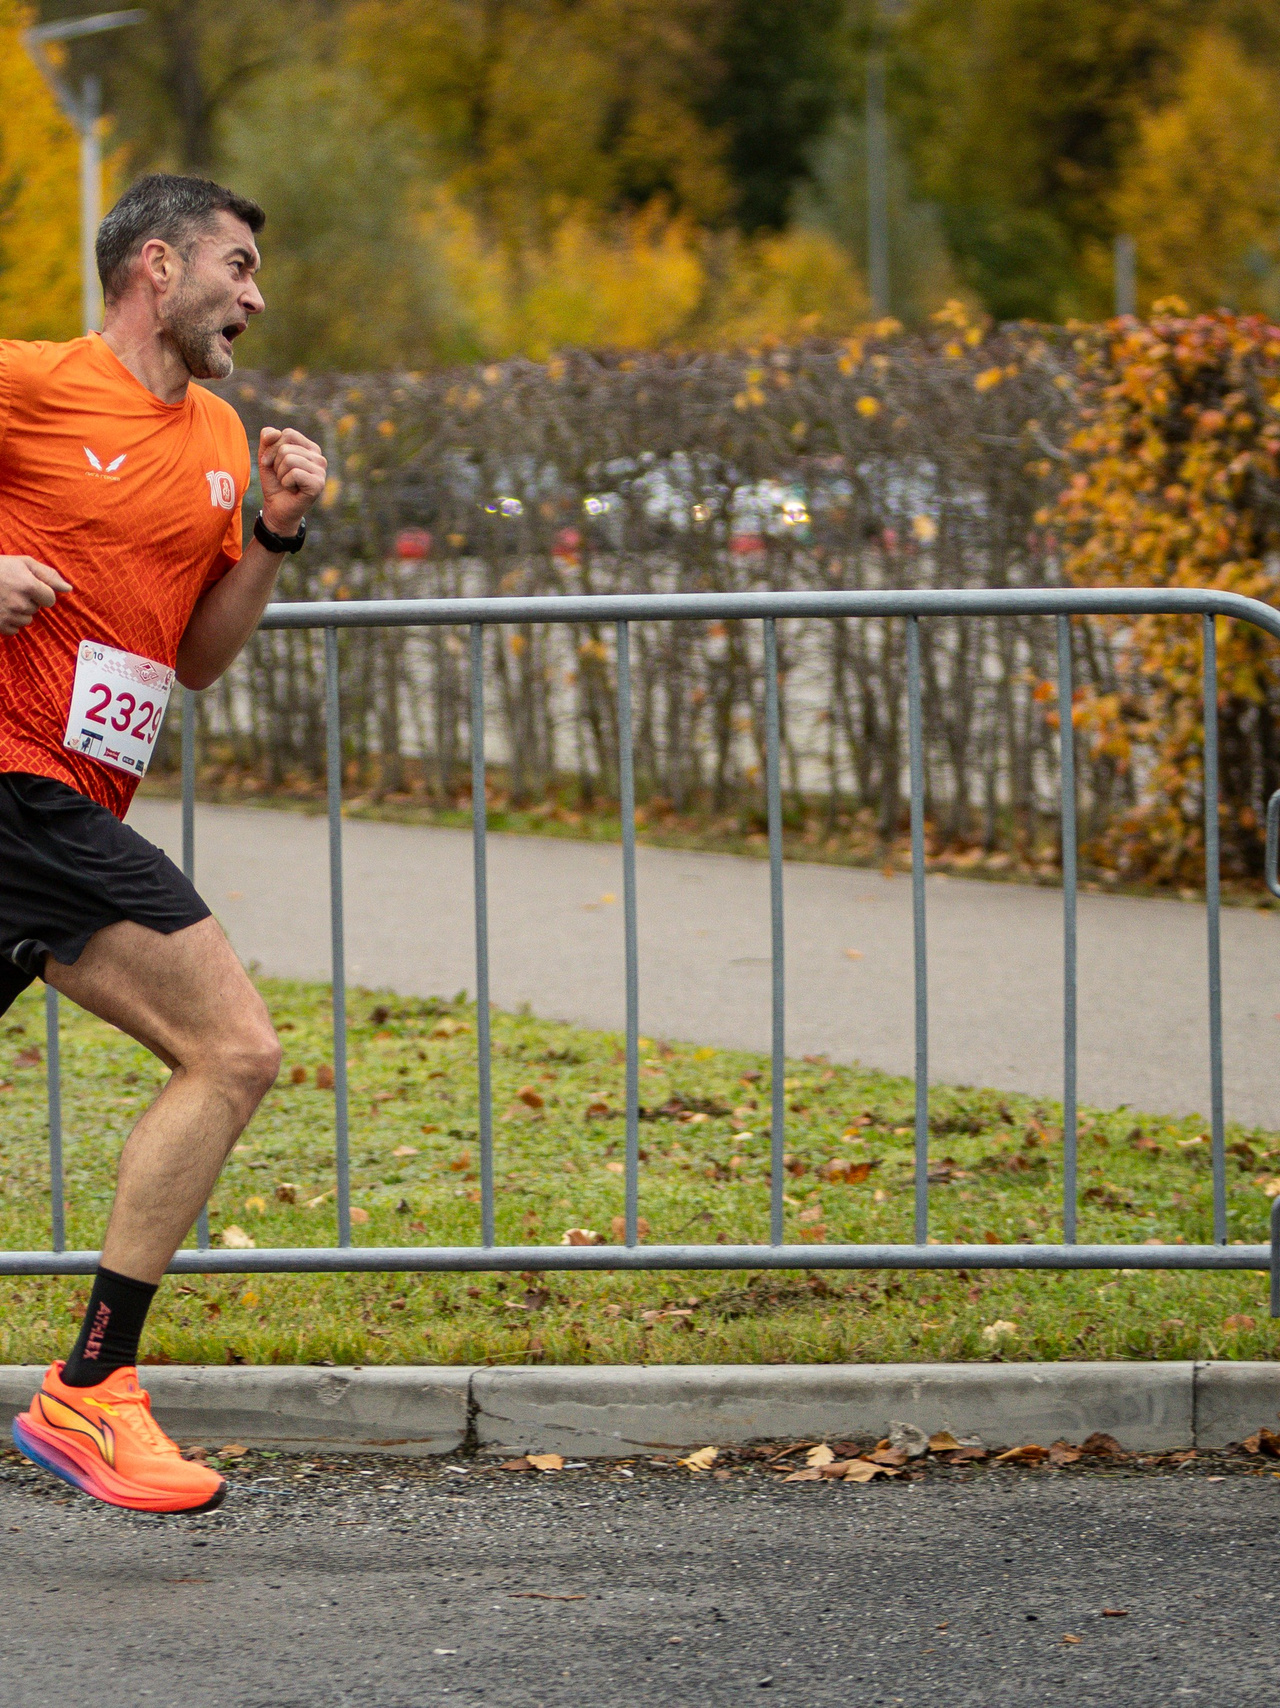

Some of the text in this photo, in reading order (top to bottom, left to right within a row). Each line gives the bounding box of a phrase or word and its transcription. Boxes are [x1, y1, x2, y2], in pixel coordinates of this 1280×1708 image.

[205, 470, 235, 510] 10
[93, 651, 104, 661] 10
[85, 683, 162, 744] 2329
[82, 1301, 112, 1360] ATHLEX
